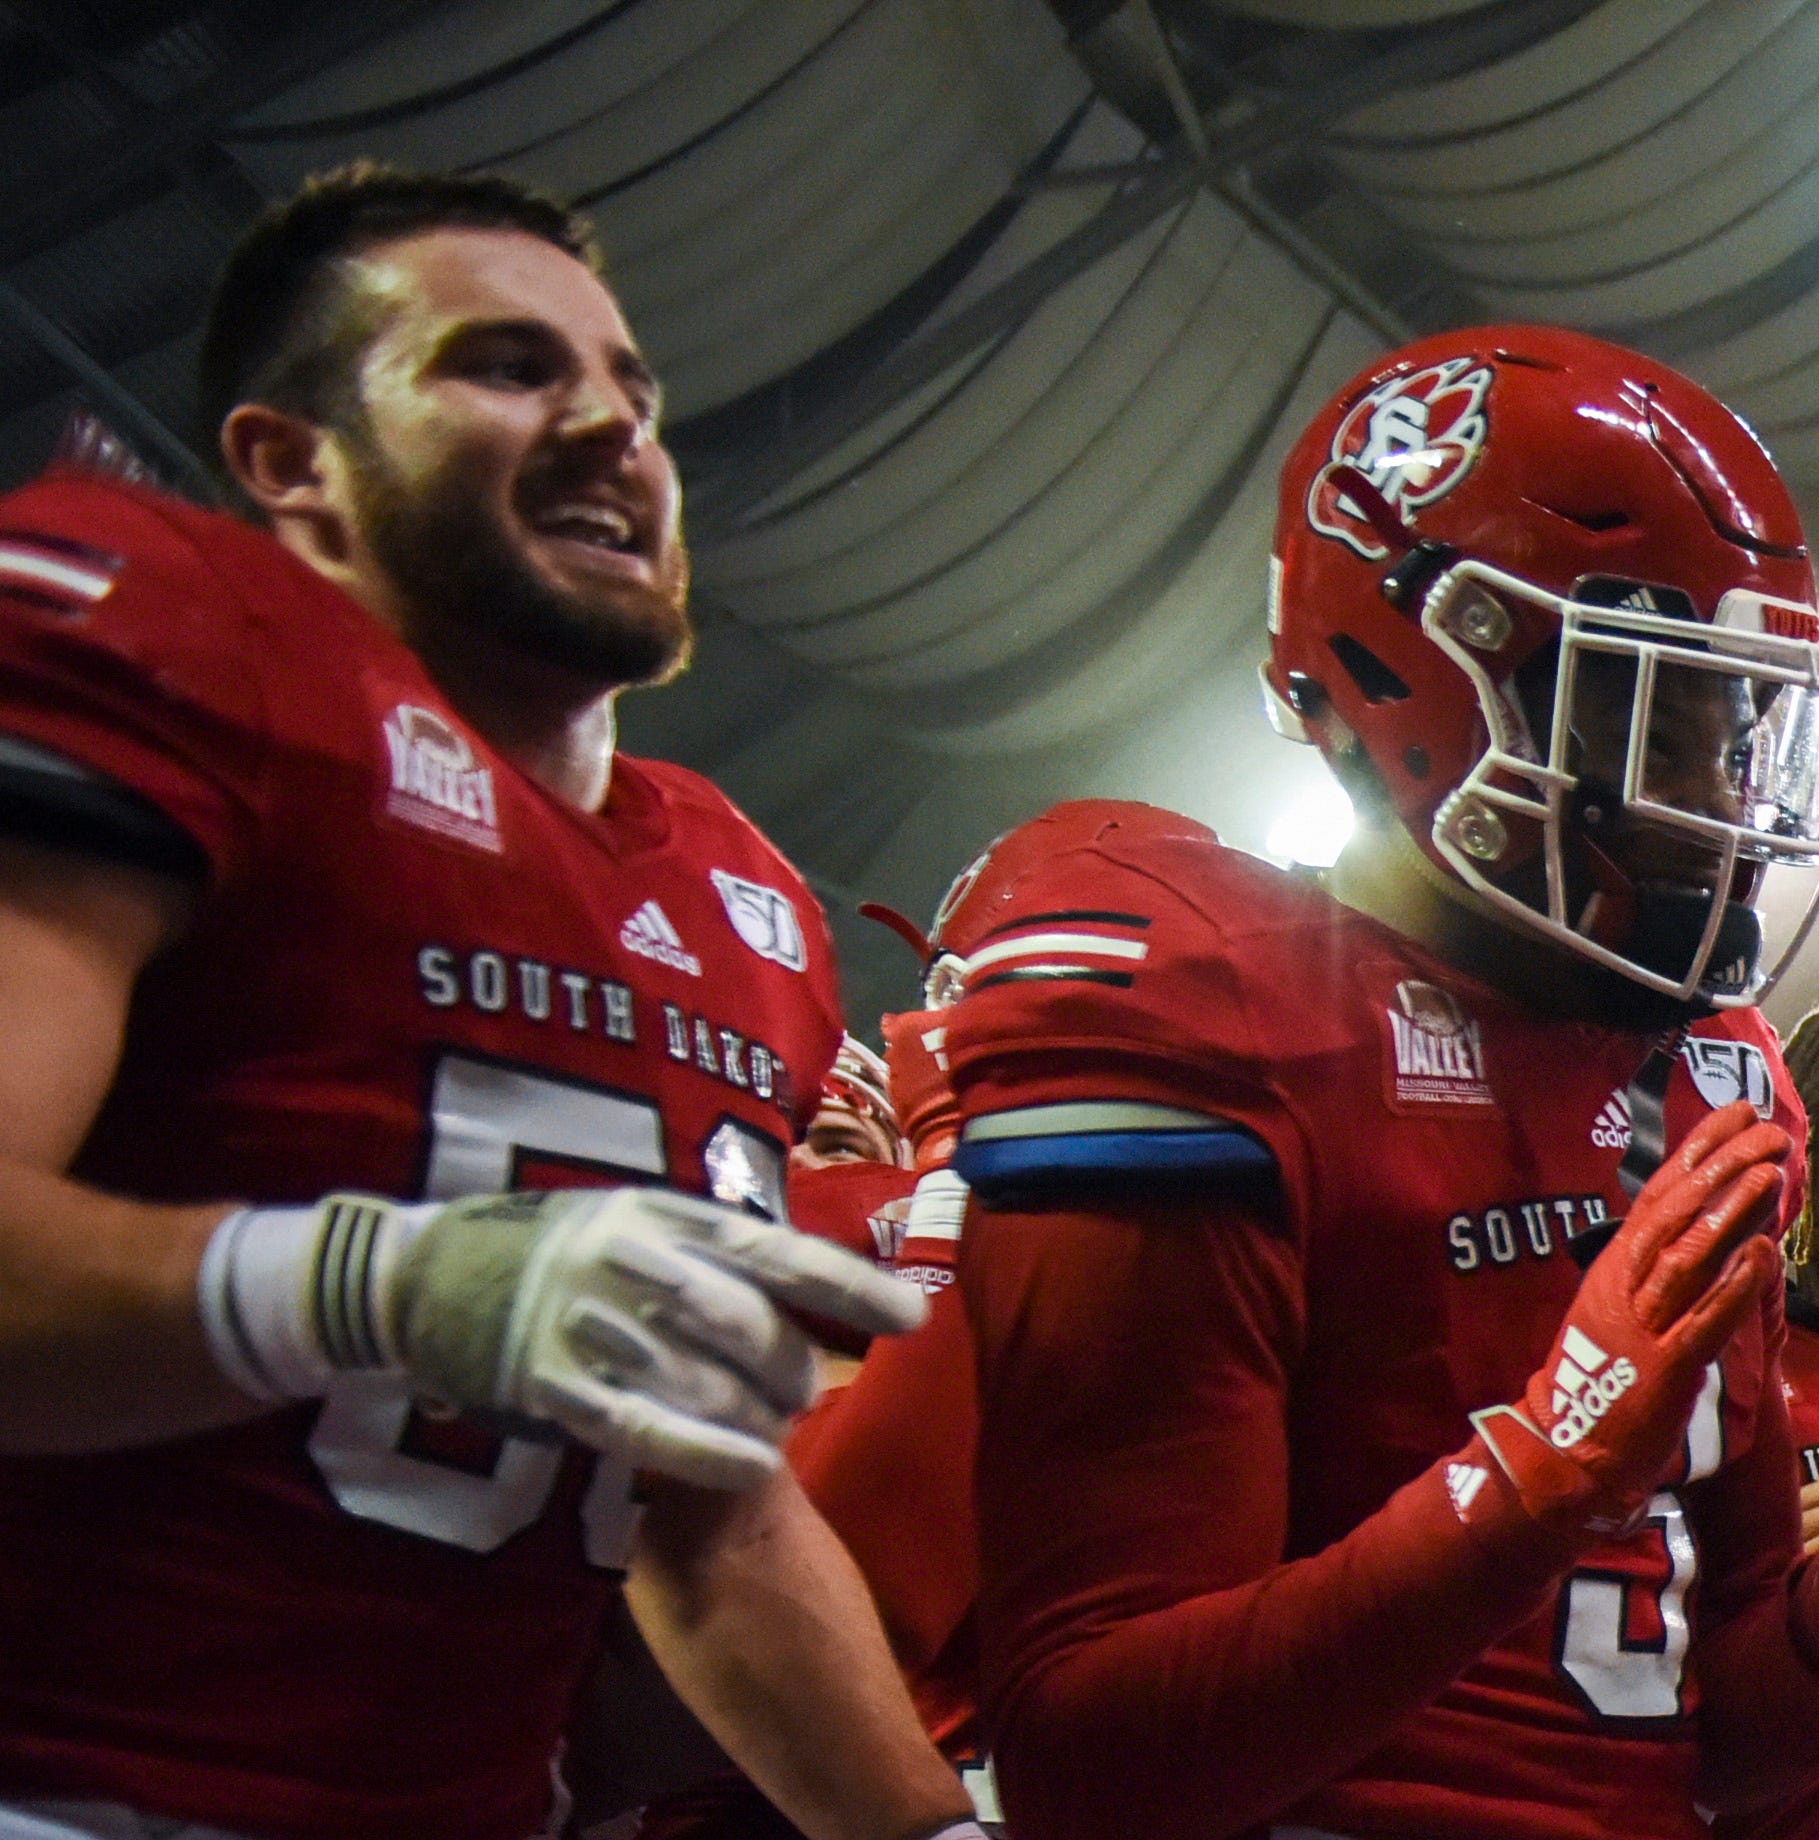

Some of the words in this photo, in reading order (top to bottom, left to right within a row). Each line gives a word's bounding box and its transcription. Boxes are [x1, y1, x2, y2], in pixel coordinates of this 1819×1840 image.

[620, 927, 702, 978] adidas
[417, 946, 637, 1043] SOUTH
[663, 1002, 784, 1099] DAKO
[1387, 1008, 1485, 1080] VALLEY
[1680, 1035, 1775, 1121] 150
[1450, 1199, 1607, 1271] SOUTH
[1550, 1356, 1639, 1448] adidas
